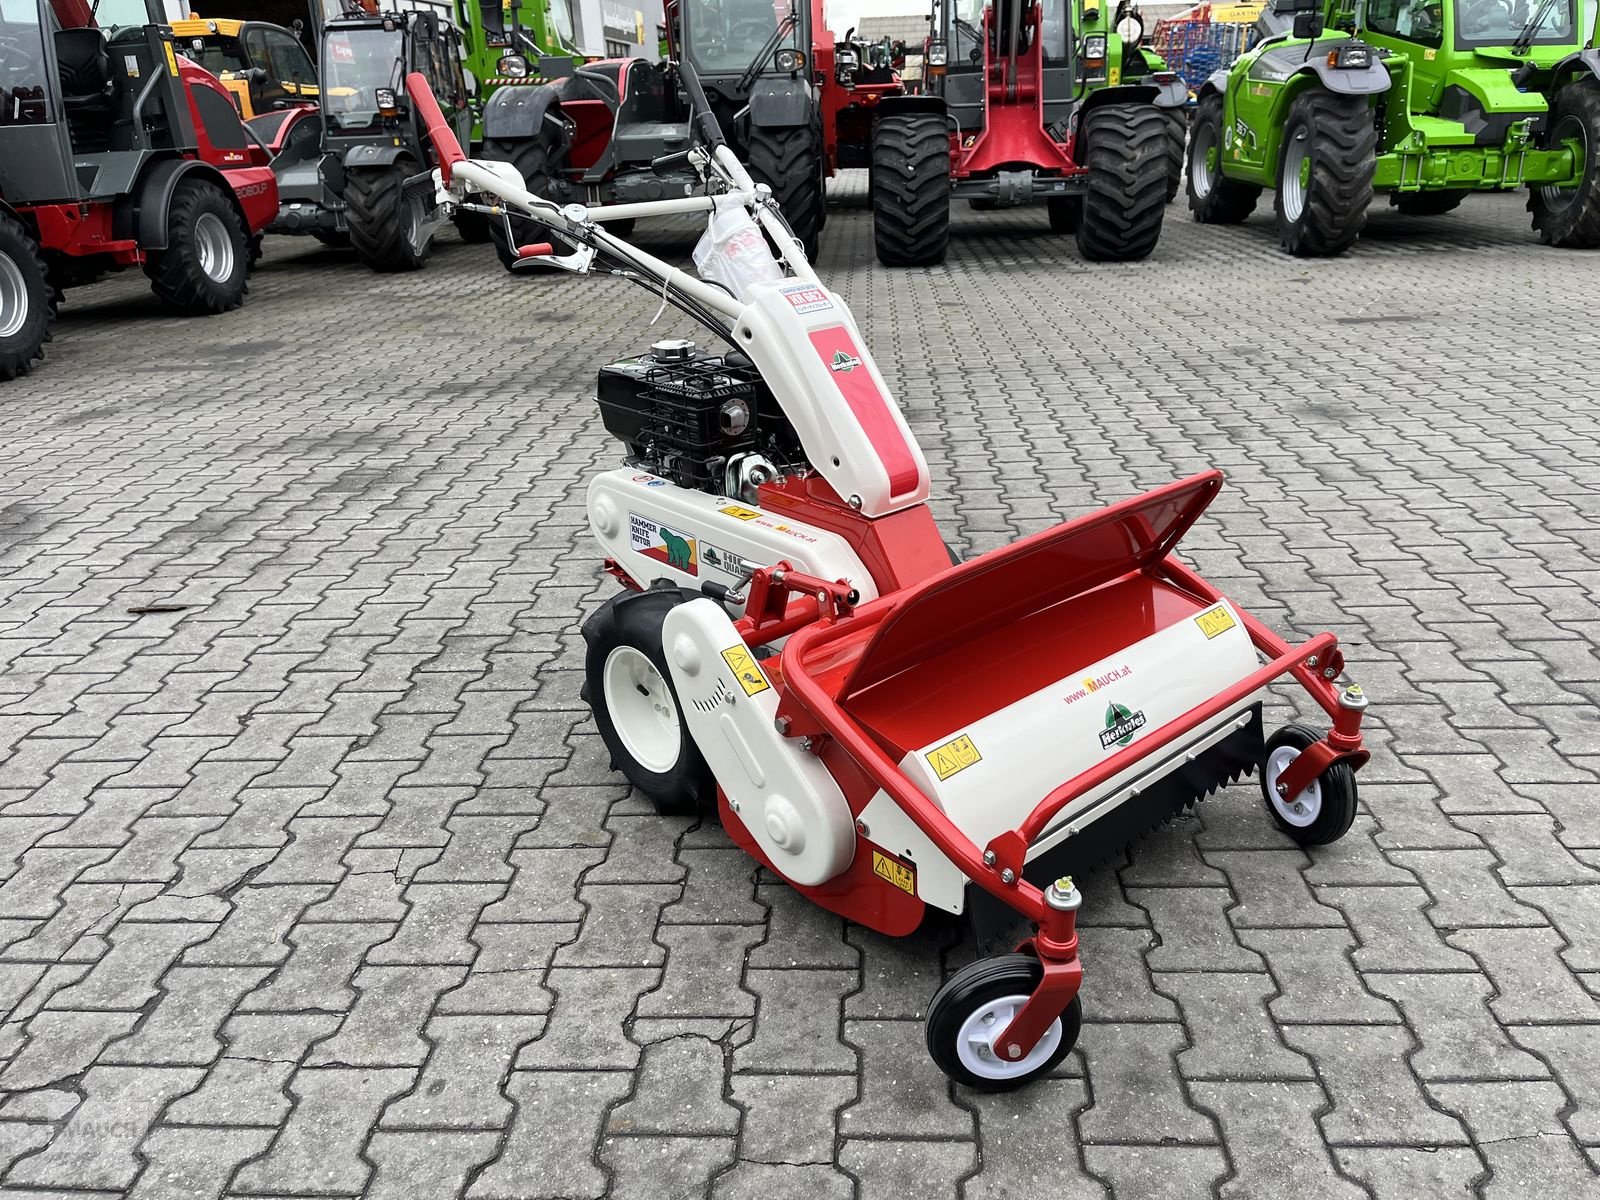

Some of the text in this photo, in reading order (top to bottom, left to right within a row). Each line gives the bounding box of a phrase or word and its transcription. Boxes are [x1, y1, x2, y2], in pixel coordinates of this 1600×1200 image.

[801, 290, 825, 303] 662
[630, 515, 657, 534] HAMMER
[631, 524, 650, 539] KNIFE
[632, 533, 651, 547] ROTOR
[1100, 714, 1146, 746] Herkules
